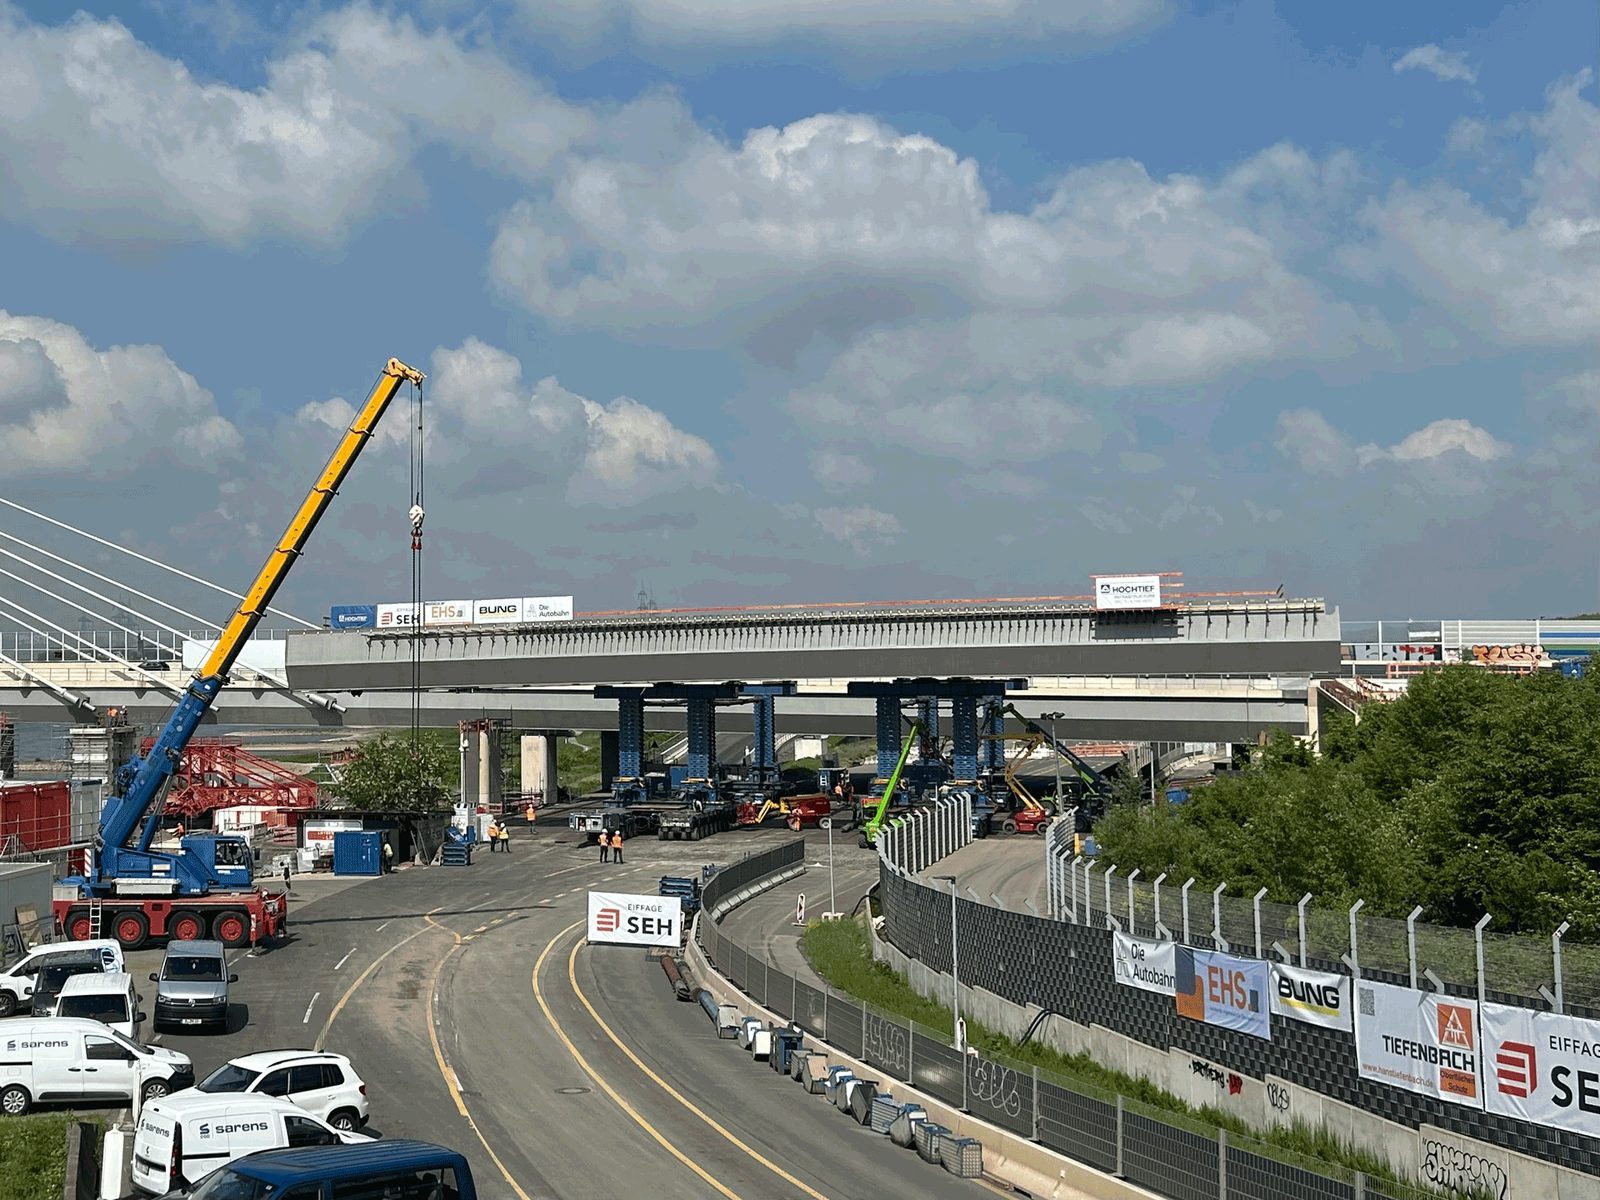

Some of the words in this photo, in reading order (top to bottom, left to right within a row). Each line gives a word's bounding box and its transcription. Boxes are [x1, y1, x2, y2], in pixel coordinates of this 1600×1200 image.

[431, 606, 455, 618] EHS
[479, 605, 517, 614] BUNG
[396, 615, 420, 624] SEH
[627, 903, 663, 913] EIFFAGE
[627, 916, 672, 936] SEH
[1131, 943, 1145, 962] Die
[1132, 963, 1176, 988] Autobahn
[1207, 965, 1248, 1010] EHS
[1278, 976, 1340, 1009] BUNG
[21, 1041, 69, 1049] sarens
[1381, 1034, 1475, 1073] TIEFENBACH
[1551, 1065, 1600, 1115] SE
[145, 1122, 170, 1138] sarens
[215, 1122, 269, 1134] sarens
